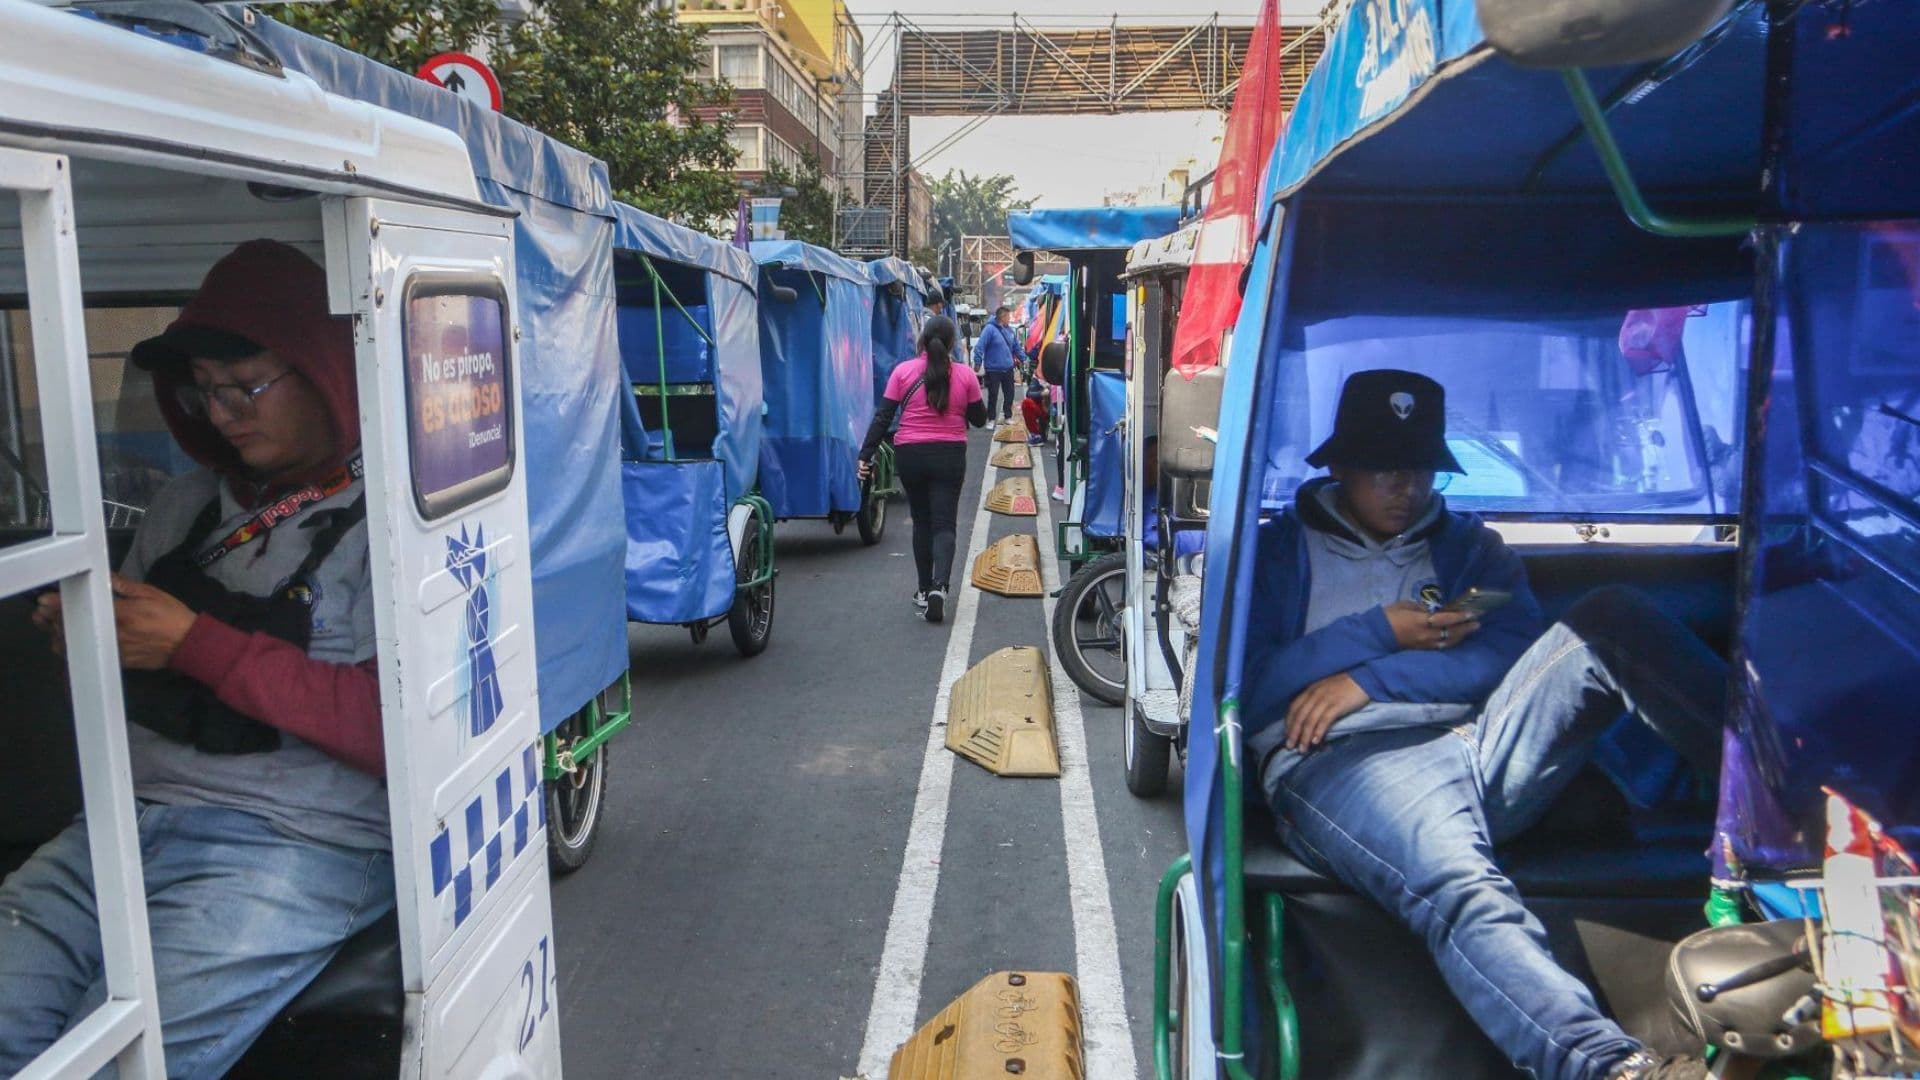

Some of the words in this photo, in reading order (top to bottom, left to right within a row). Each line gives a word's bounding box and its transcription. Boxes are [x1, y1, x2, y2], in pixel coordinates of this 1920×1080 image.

[422, 352, 440, 383] No
[443, 358, 456, 379] es
[457, 345, 495, 382] piropo,
[422, 396, 445, 433] es
[448, 383, 501, 425] acoso
